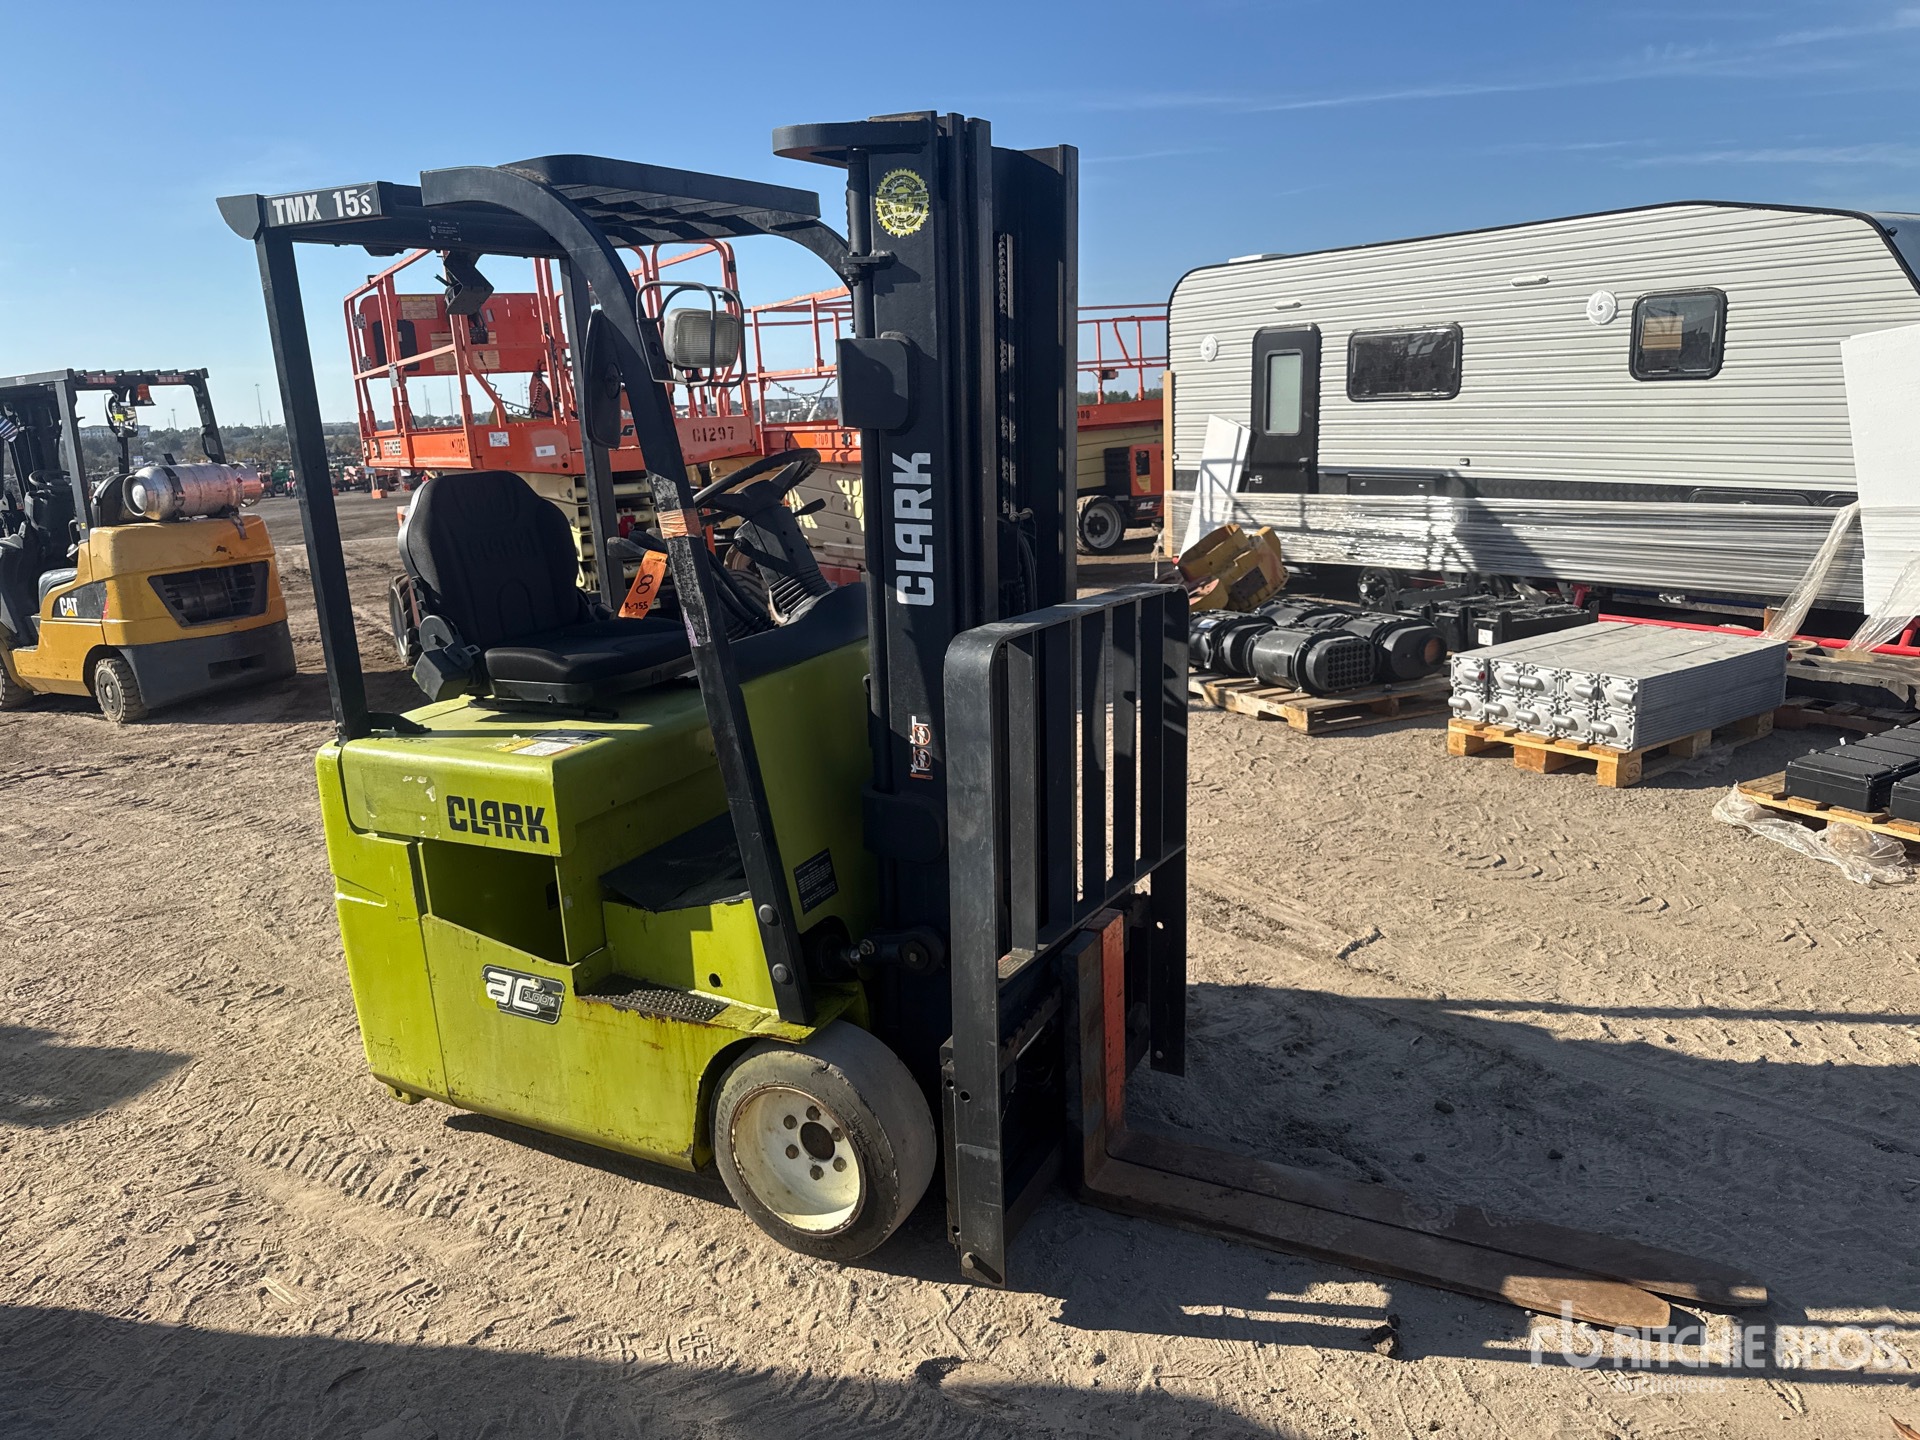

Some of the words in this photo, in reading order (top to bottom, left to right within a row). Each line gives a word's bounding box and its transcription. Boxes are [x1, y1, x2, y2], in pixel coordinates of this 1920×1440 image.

[272, 194, 322, 225] TMX
[692, 426, 735, 442] C1297
[891, 452, 934, 607] CLARK
[636, 574, 654, 594] 8
[59, 597, 78, 617] CAT
[446, 795, 550, 844] CLARK
